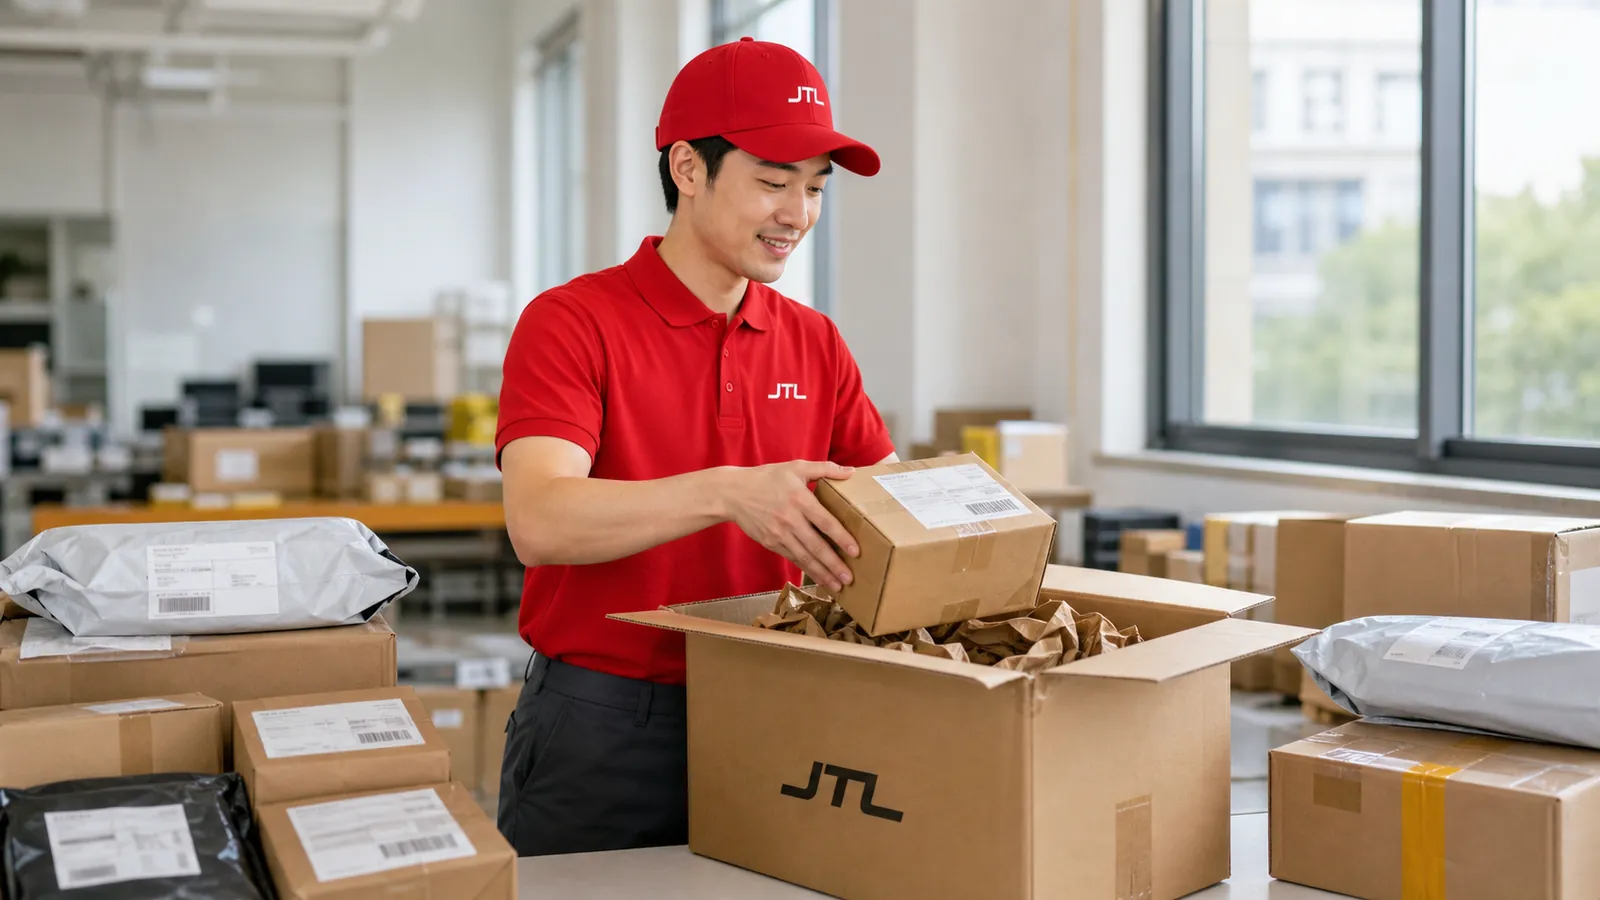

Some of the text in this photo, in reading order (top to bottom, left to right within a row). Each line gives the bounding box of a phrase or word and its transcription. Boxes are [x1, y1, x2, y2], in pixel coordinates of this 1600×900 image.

[788, 86, 825, 106] JTL
[767, 382, 807, 400] JTL
[780, 760, 904, 823] JTL
